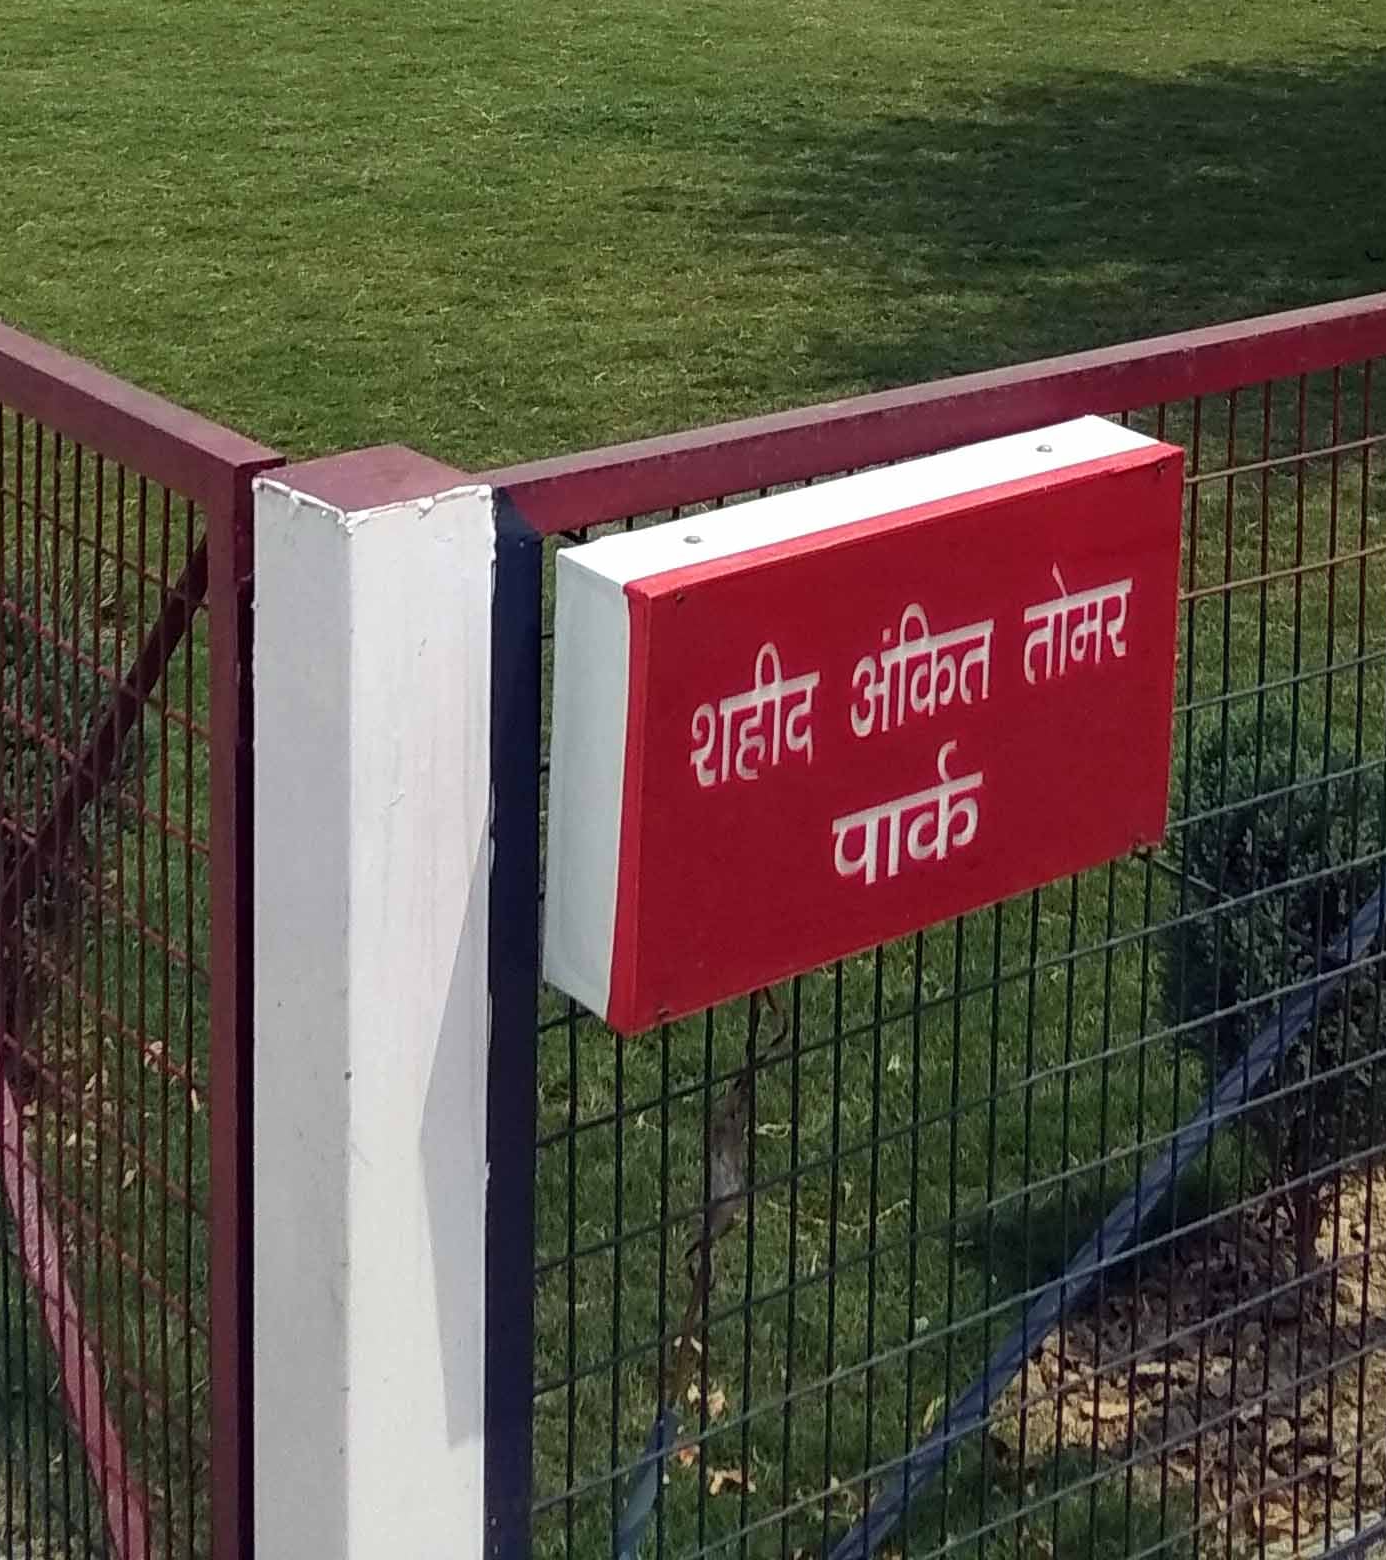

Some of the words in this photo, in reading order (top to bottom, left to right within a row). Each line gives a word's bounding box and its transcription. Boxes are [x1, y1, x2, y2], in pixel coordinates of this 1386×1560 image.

[688, 640, 820, 788] शहीद
[850, 601, 995, 740] अंकित
[1022, 562, 1134, 686] तोमर
[832, 740, 985, 885] पार्क
